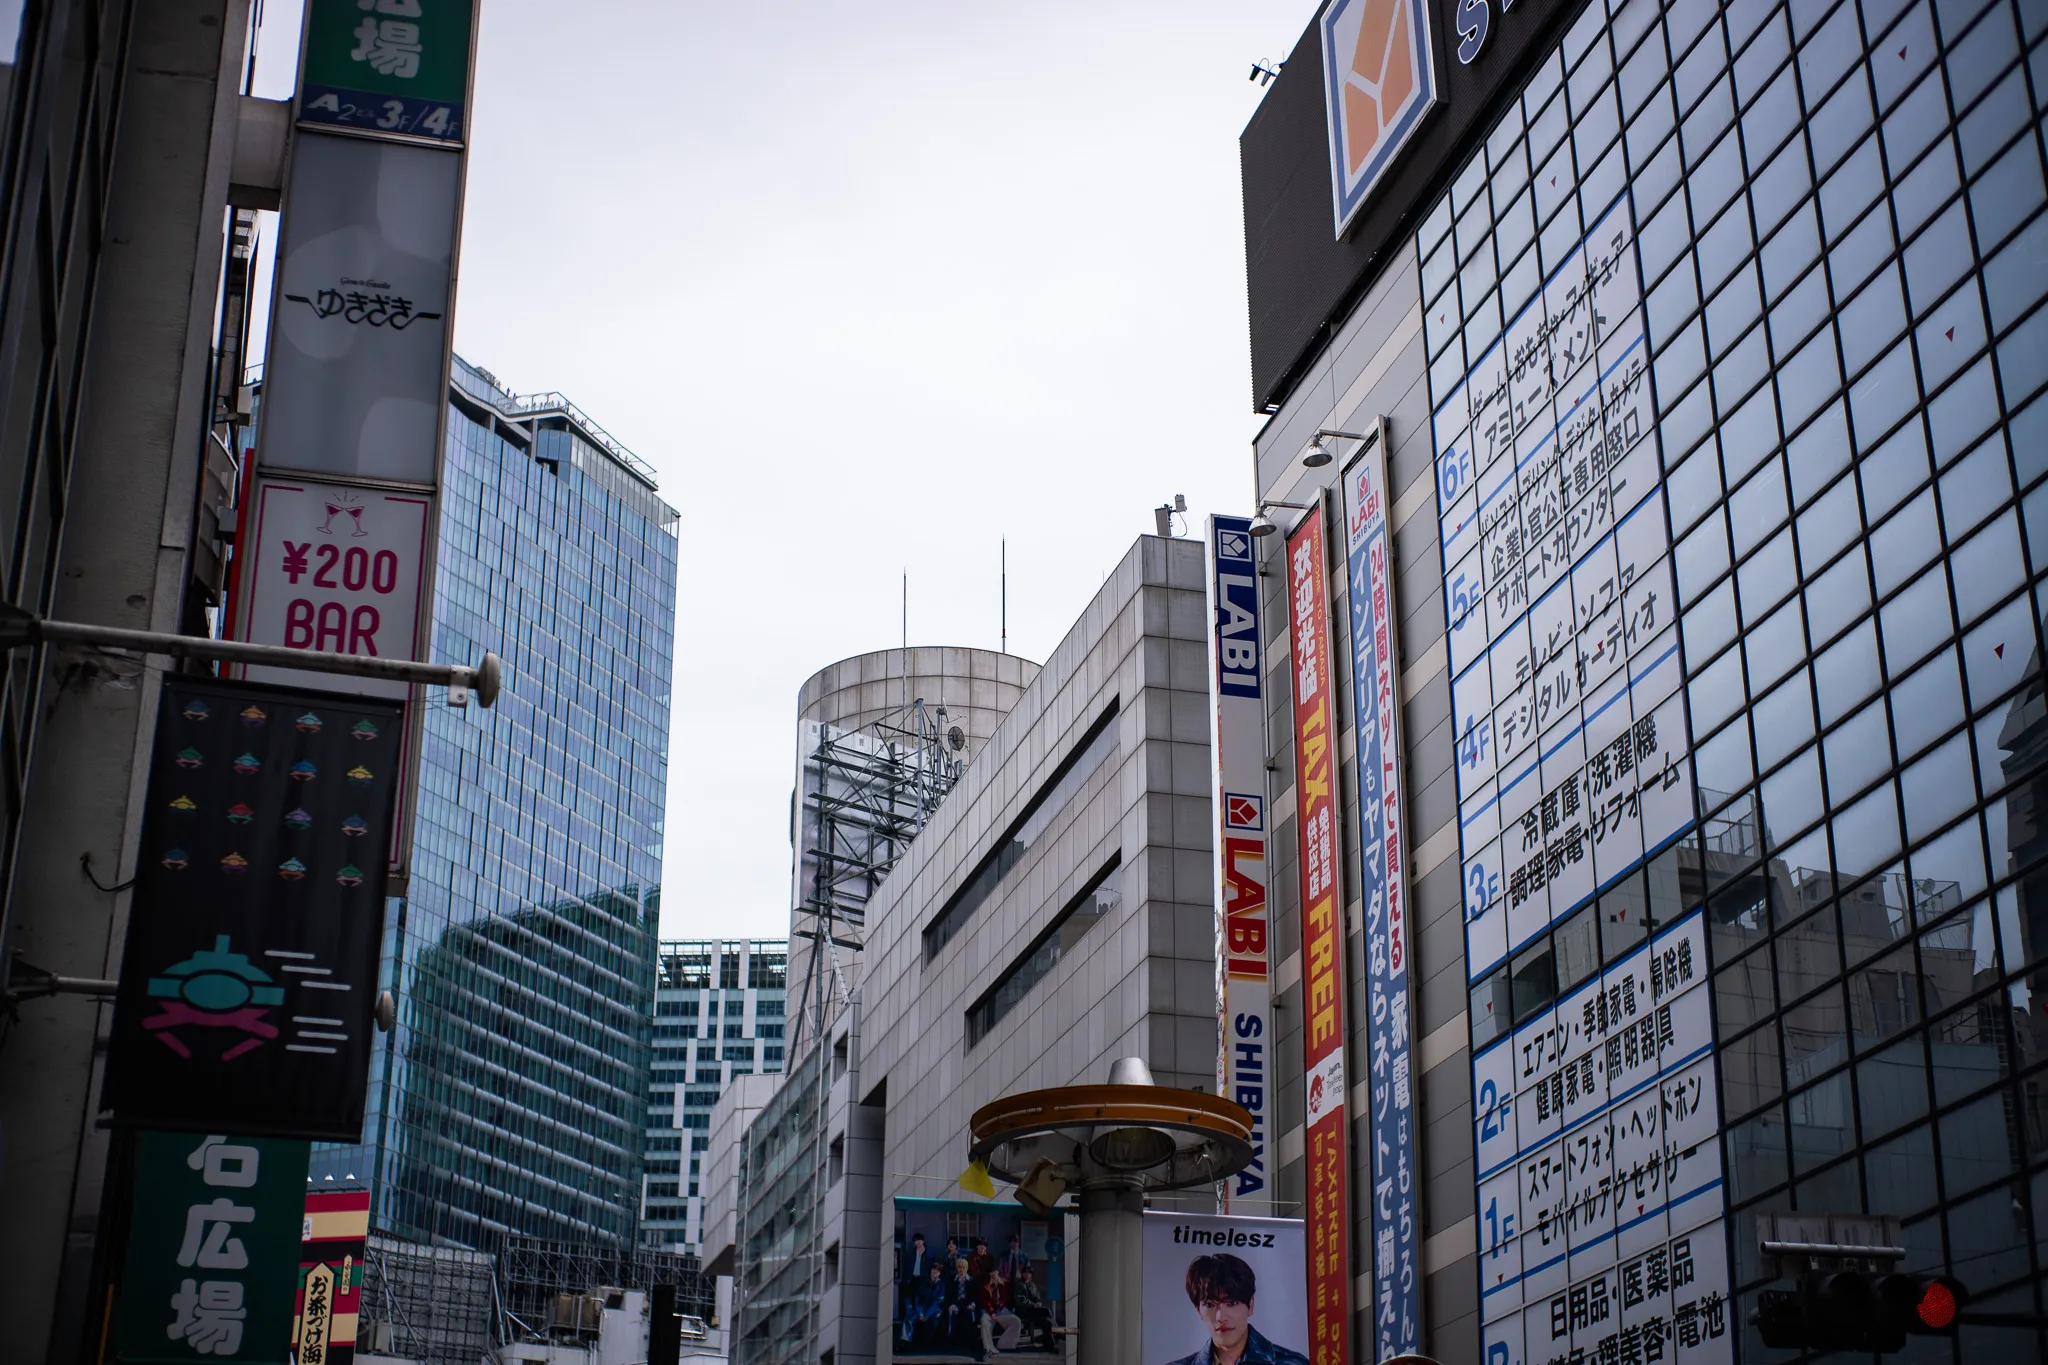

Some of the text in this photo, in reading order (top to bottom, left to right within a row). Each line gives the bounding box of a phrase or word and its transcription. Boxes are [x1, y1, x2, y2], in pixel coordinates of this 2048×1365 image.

[317, 289, 414, 330] ゆきざき
[1484, 306, 1607, 463] アミューズメント
[1351, 488, 1380, 535] LABI
[1352, 512, 1381, 546] SHIBUYA
[1441, 446, 1470, 502] 6F
[1491, 405, 1641, 582] 企業・官公庁専用窓口
[282, 540, 398, 594] ¥200
[1452, 572, 1480, 632] 5F
[1496, 477, 1628, 620] サポートカウンター
[284, 598, 380, 657] BAR
[1219, 572, 1258, 687] LABI
[1293, 538, 1318, 706] 欢迎光临
[1503, 590, 1658, 755] デジタルオーディオ
[1516, 562, 1636, 696] テレビ・ソファ
[1302, 695, 1329, 816] TAX
[1460, 713, 1490, 771] 4F
[1520, 711, 1659, 854] 冷蔵庫・洗濯機
[1306, 815, 1320, 900] 供应店
[1318, 805, 1332, 889] 免税品
[1509, 751, 1681, 911] 調理家電・リフォーム
[1225, 837, 1268, 980] LABI
[1469, 862, 1499, 921] 3F
[1309, 893, 1336, 1051] FREE
[1369, 542, 1417, 1358] 24時間ネットで買える 家電はもちろん
[1523, 936, 1694, 1079] エアコン・季節家電・掃除機
[1480, 1079, 1512, 1144] 2F
[1536, 1004, 1675, 1125] 健康家電・照明器具
[1528, 1074, 1702, 1202] スマートフォン・ヘッドホン
[1537, 1140, 1698, 1247] モバイルアクセサリー
[1174, 1225, 1276, 1249] timelesz
[1484, 1196, 1515, 1260] 1F
[1551, 1238, 1695, 1342] 日用品・医薬品
